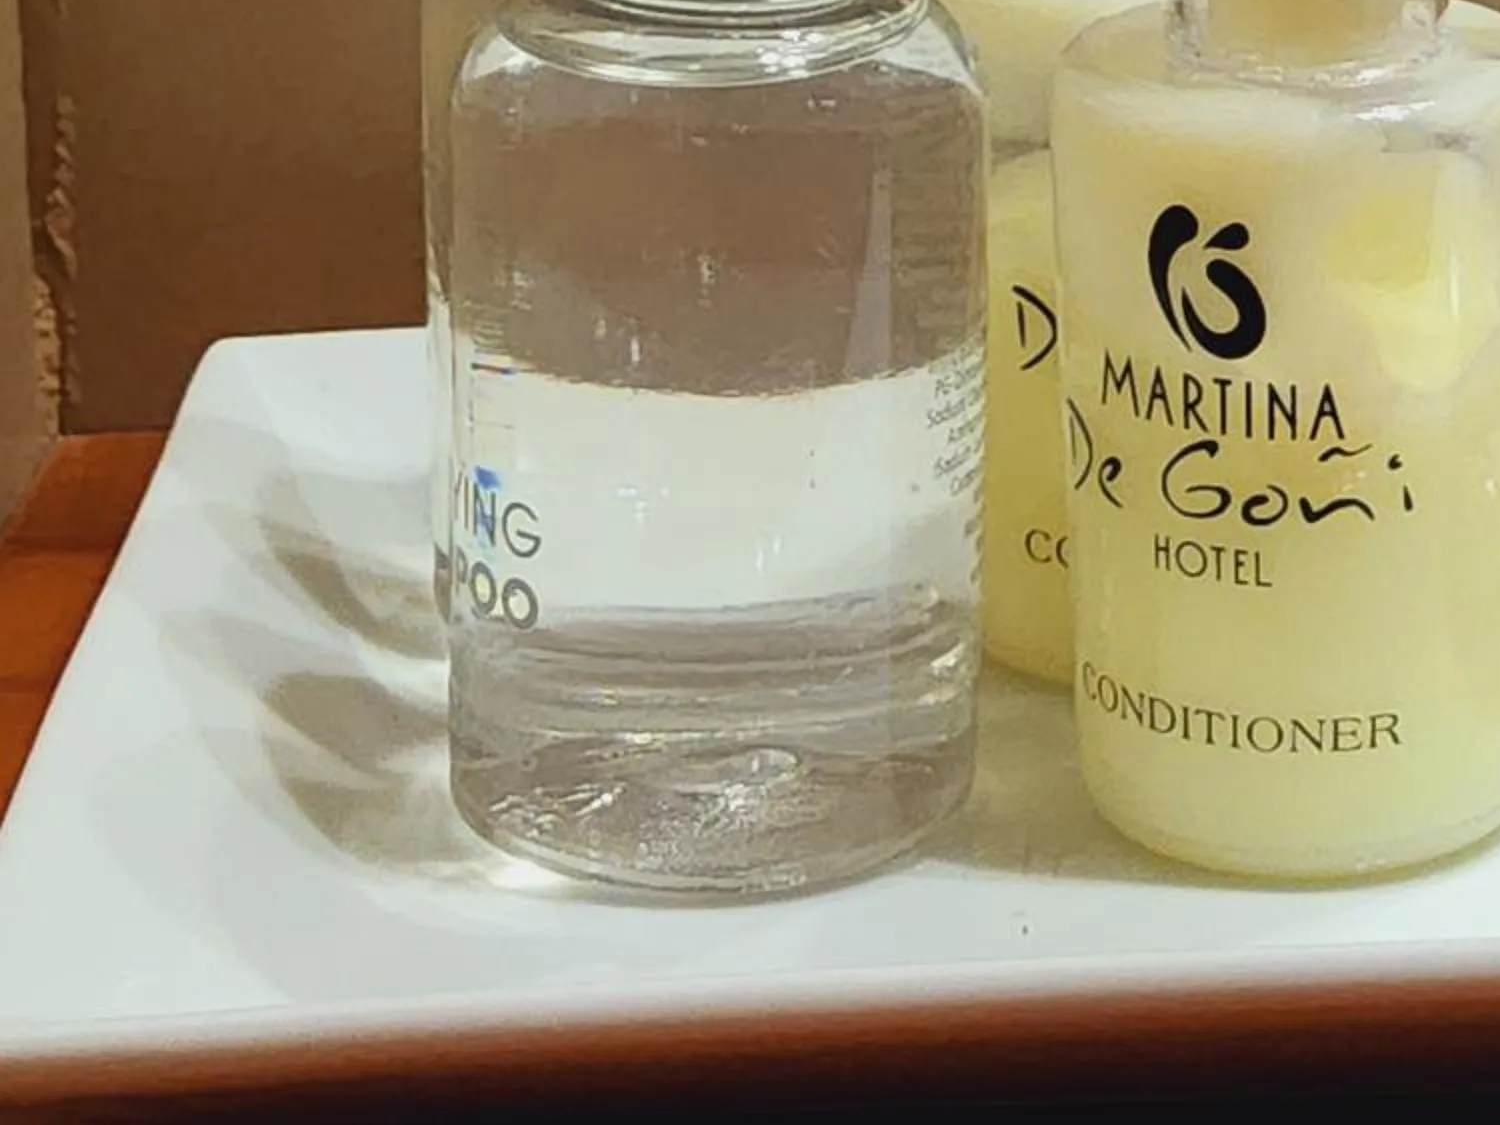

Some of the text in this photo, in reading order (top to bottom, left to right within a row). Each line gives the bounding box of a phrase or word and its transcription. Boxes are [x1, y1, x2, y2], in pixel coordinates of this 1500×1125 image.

[1101, 348, 1345, 441] MARTINA
[1066, 396, 1124, 509] De
[1161, 439, 1414, 527] Goñi
[1153, 533, 1273, 588] HOTEL
[1081, 661, 1403, 754] CONDITIONER
